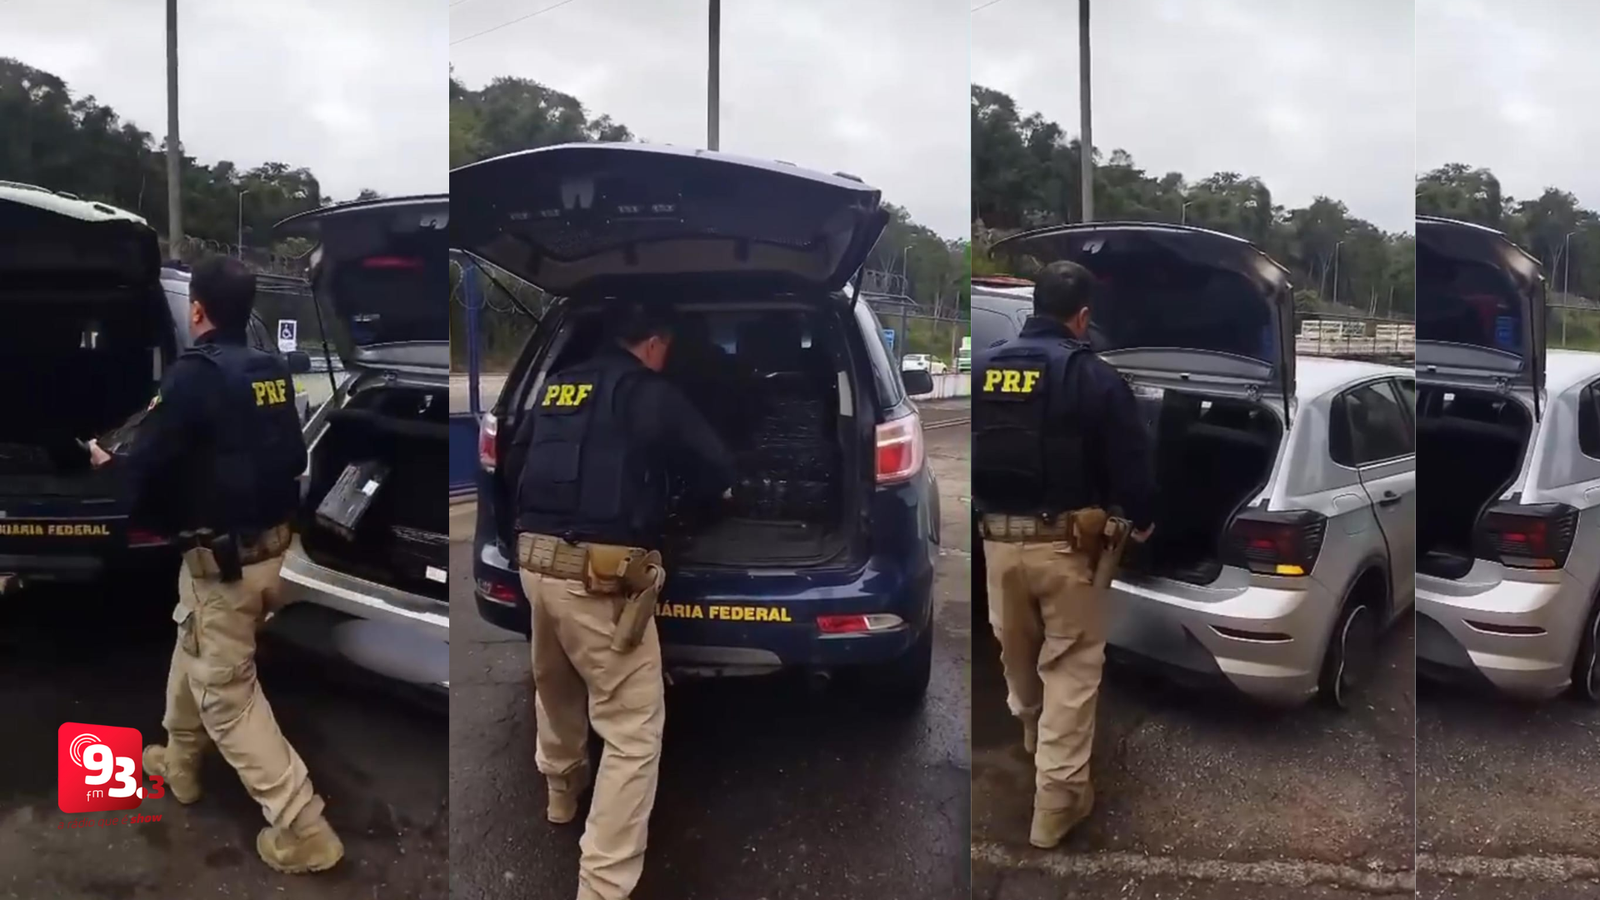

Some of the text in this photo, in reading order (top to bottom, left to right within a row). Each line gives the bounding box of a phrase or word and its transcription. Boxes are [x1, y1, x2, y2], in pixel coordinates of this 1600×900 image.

[983, 369, 1040, 392] PRF
[252, 379, 286, 406] PRF
[542, 384, 592, 406] PRF
[48, 524, 110, 535] FEDERAL
[709, 606, 792, 622] FEDERAL
